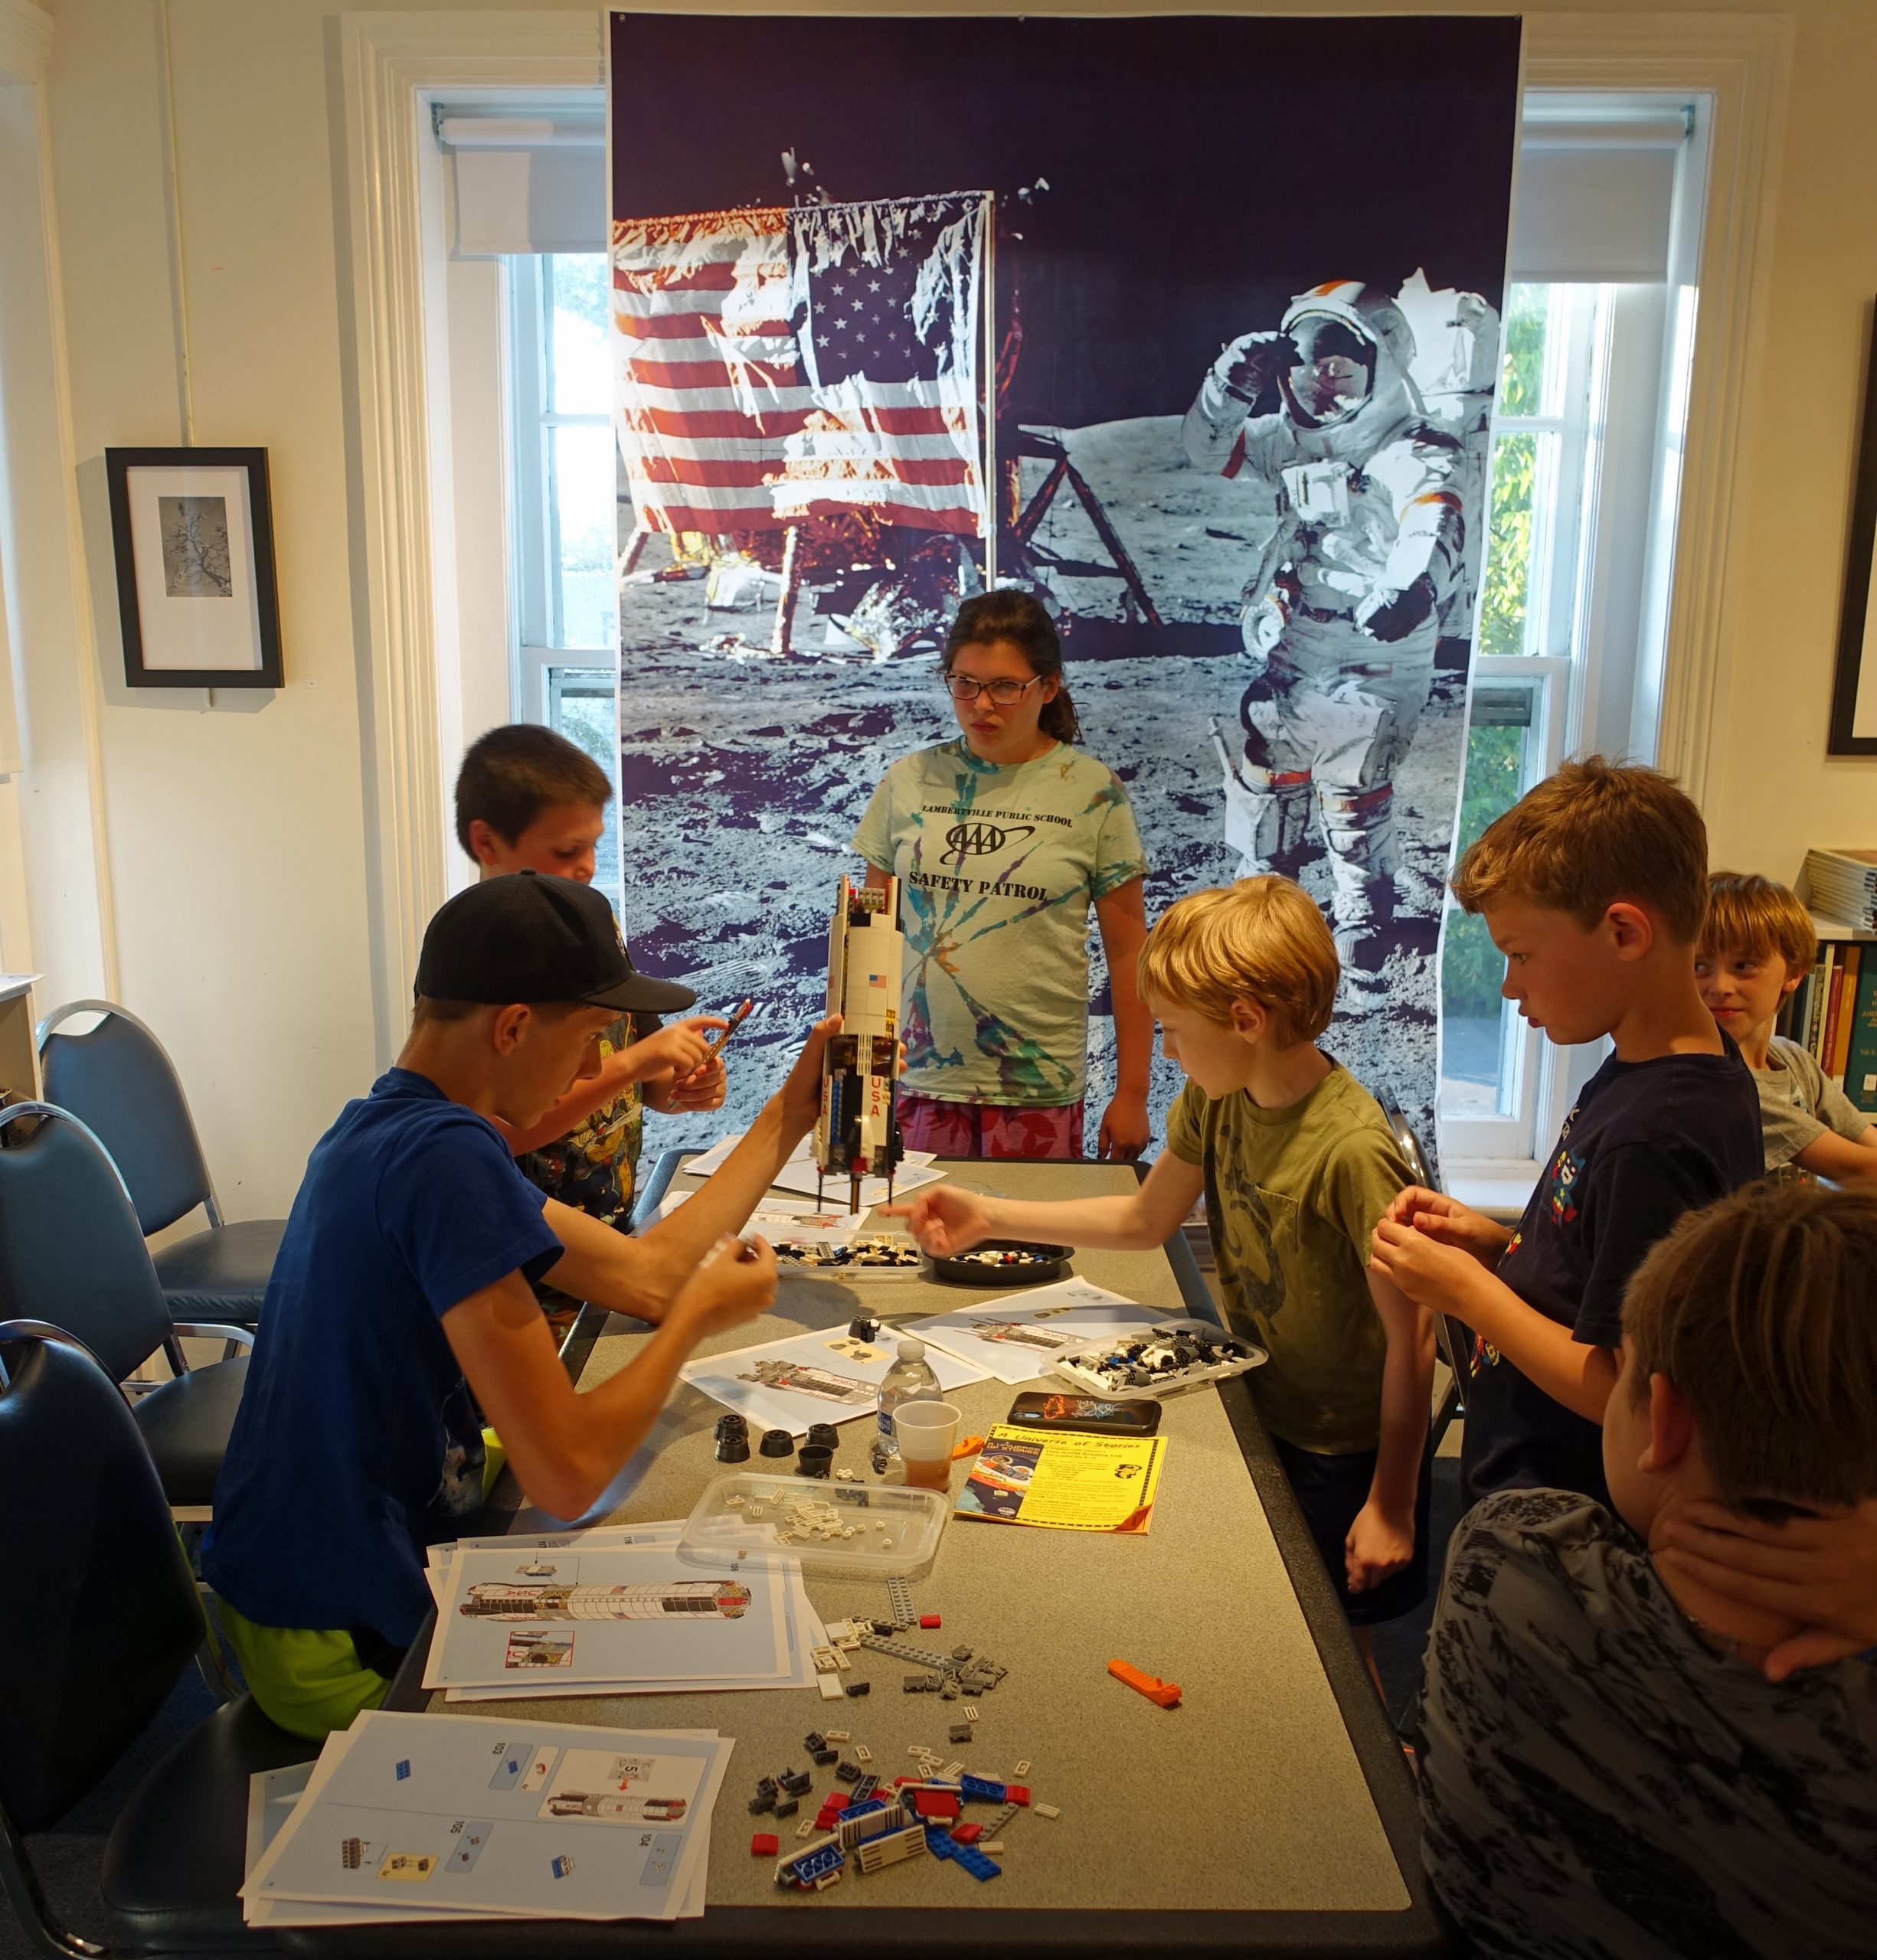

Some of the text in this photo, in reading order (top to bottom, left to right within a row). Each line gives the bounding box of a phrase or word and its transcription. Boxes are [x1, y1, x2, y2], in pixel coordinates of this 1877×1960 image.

[922, 805, 1073, 828] LAMBERTVILLE PUBLIC SCHOOL
[909, 871, 1048, 901] SAFETY PATROL
[870, 1077, 881, 1117] USA
[1015, 1434, 1067, 1446] Universe
[492, 1742, 506, 1755] 103
[450, 1821, 465, 1834] 105
[638, 1834, 652, 1847] 104
